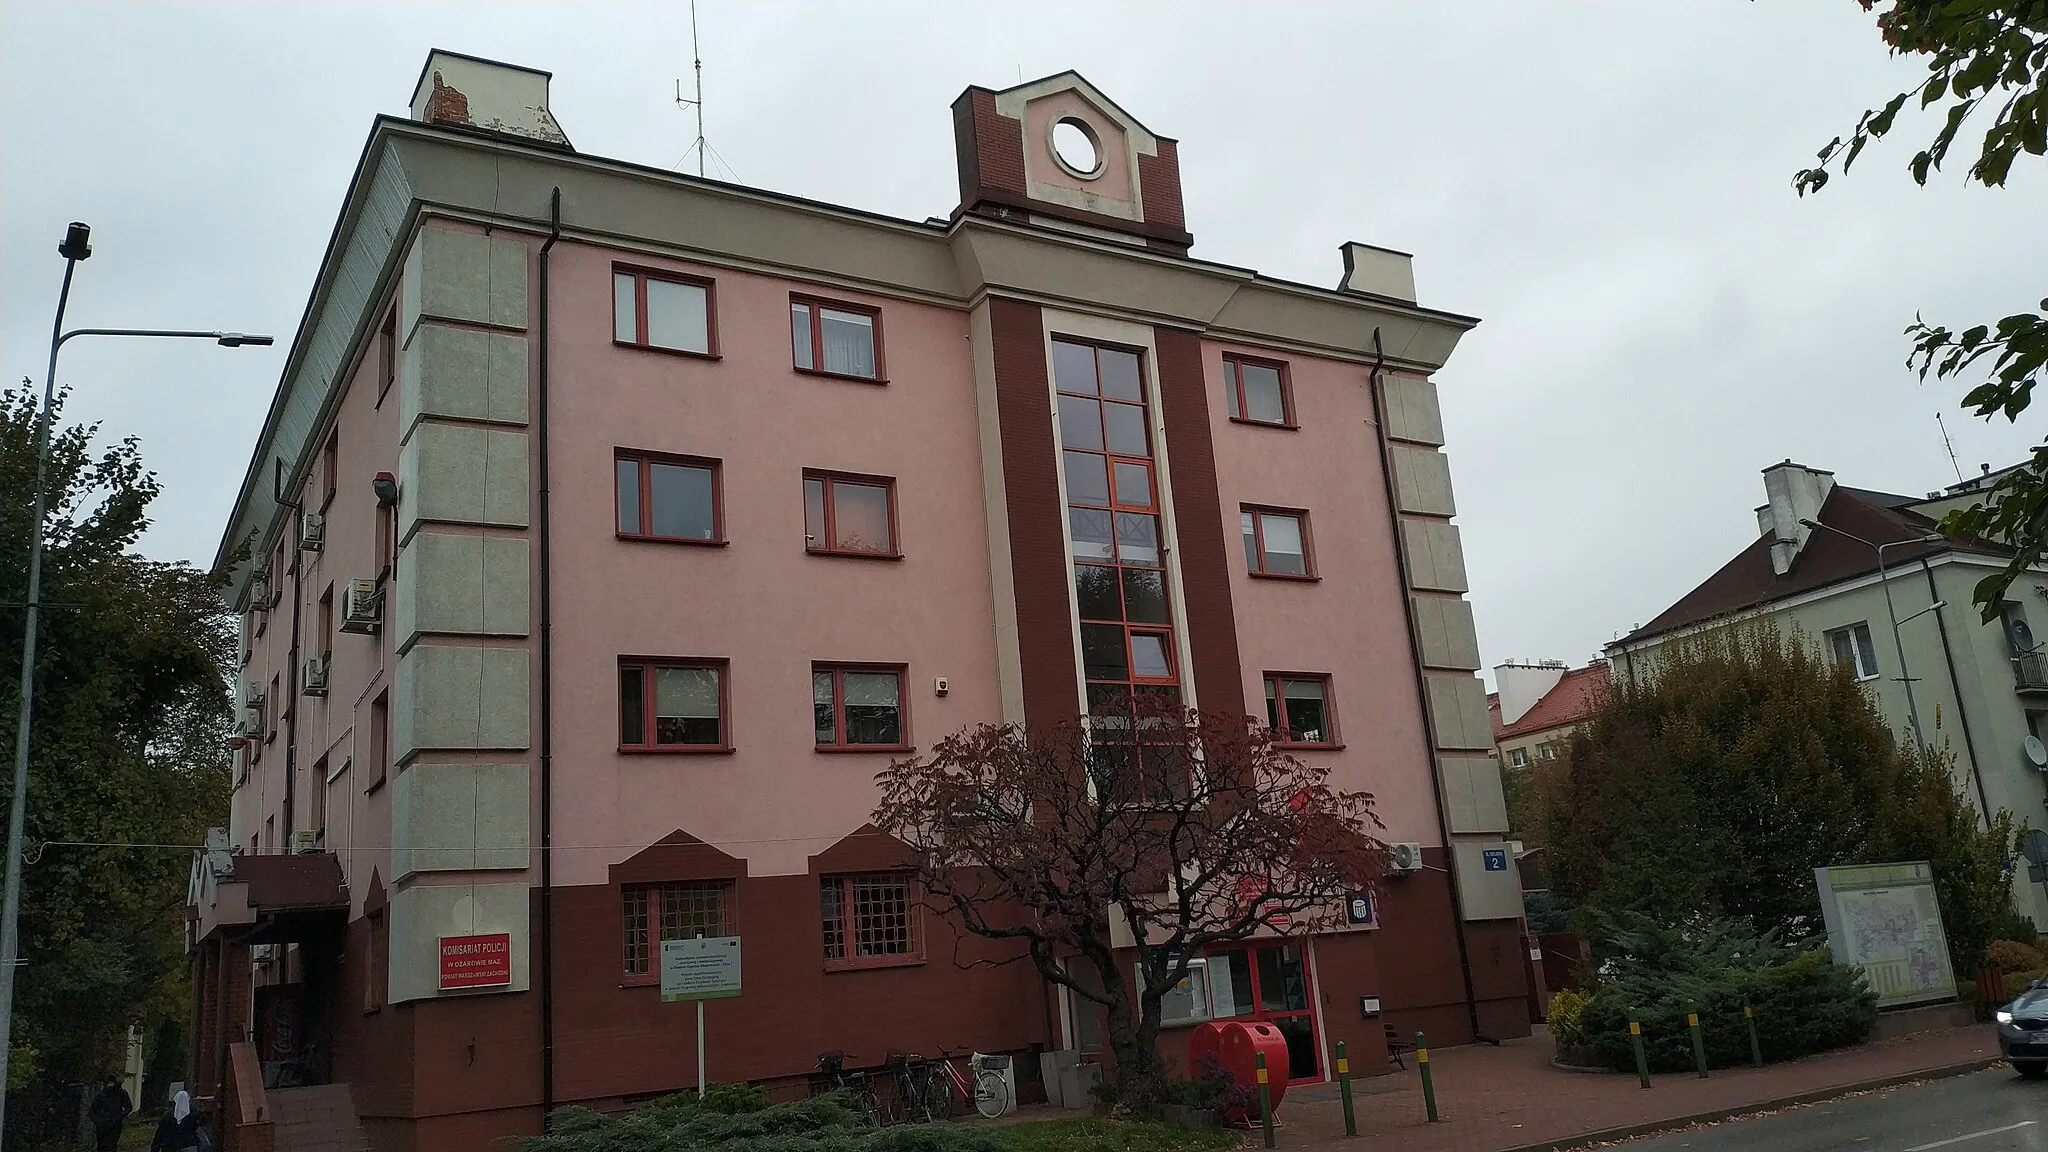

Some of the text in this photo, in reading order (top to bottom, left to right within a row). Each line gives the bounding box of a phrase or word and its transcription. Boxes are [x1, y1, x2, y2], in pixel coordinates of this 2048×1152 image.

[1492, 858, 1500, 869] 2
[442, 942, 507, 956] KOMISARIAT POLICJI
